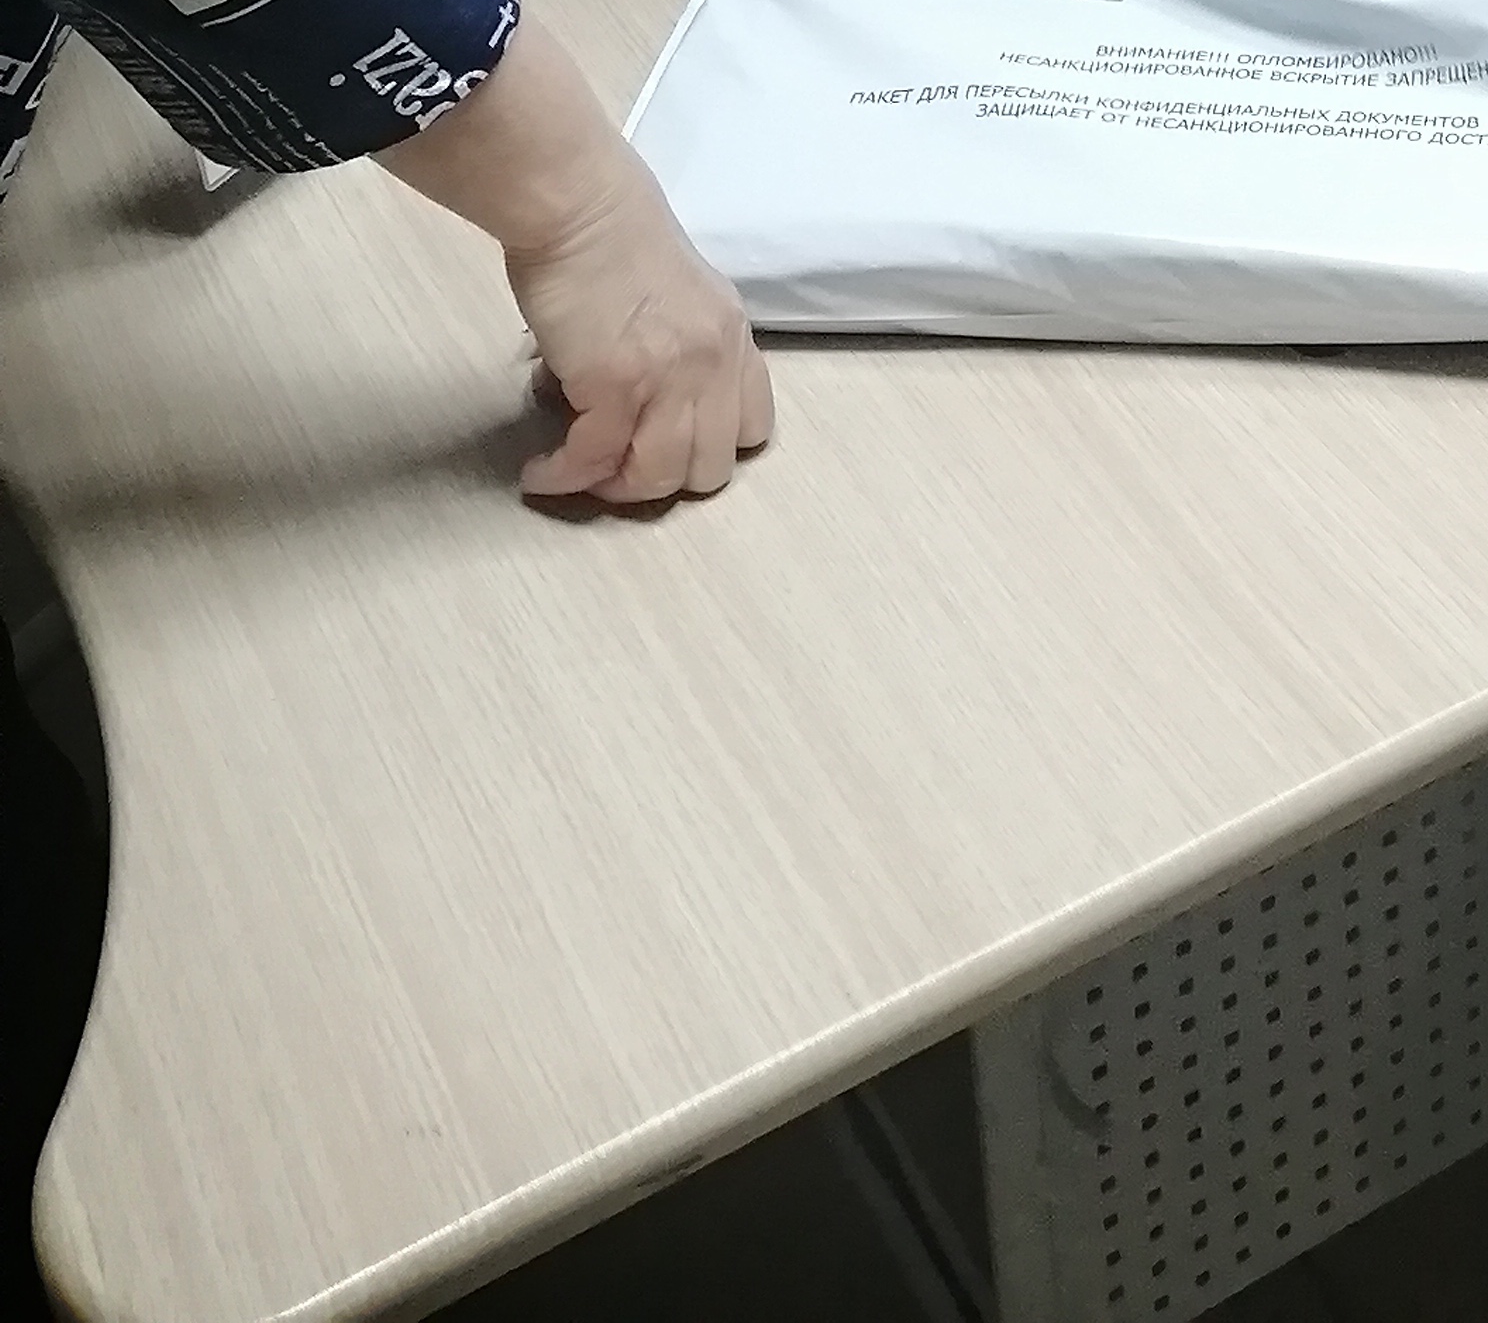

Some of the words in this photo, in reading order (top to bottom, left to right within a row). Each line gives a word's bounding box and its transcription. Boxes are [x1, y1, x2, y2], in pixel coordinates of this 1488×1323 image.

[999, 51, 1264, 81] НЕСАНКЦИОНИРОВАННОЕ
[1269, 69, 1378, 87] ВСКРЫТИЕ
[1095, 44, 1230, 65] ВНИМАНИЕ!!!
[1237, 43, 1438, 70] ОПЛОМБИРОВАНО!!!
[849, 88, 914, 105] ПАКЕТ
[916, 85, 958, 105] ДЛЯ
[965, 84, 1090, 106] ПЕРЕСЫЛКИ
[1095, 96, 1331, 122] КОНФИДЕНЦИАЛЬНЫХ
[1335, 110, 1480, 129] ДОКУМЕНТОВ
[974, 103, 1096, 120] ЗАЩИЩАЕТ
[1100, 111, 1130, 125] ОТ
[1135, 115, 1423, 143] НЕСАНКЦИОНИРОВАННОГО
